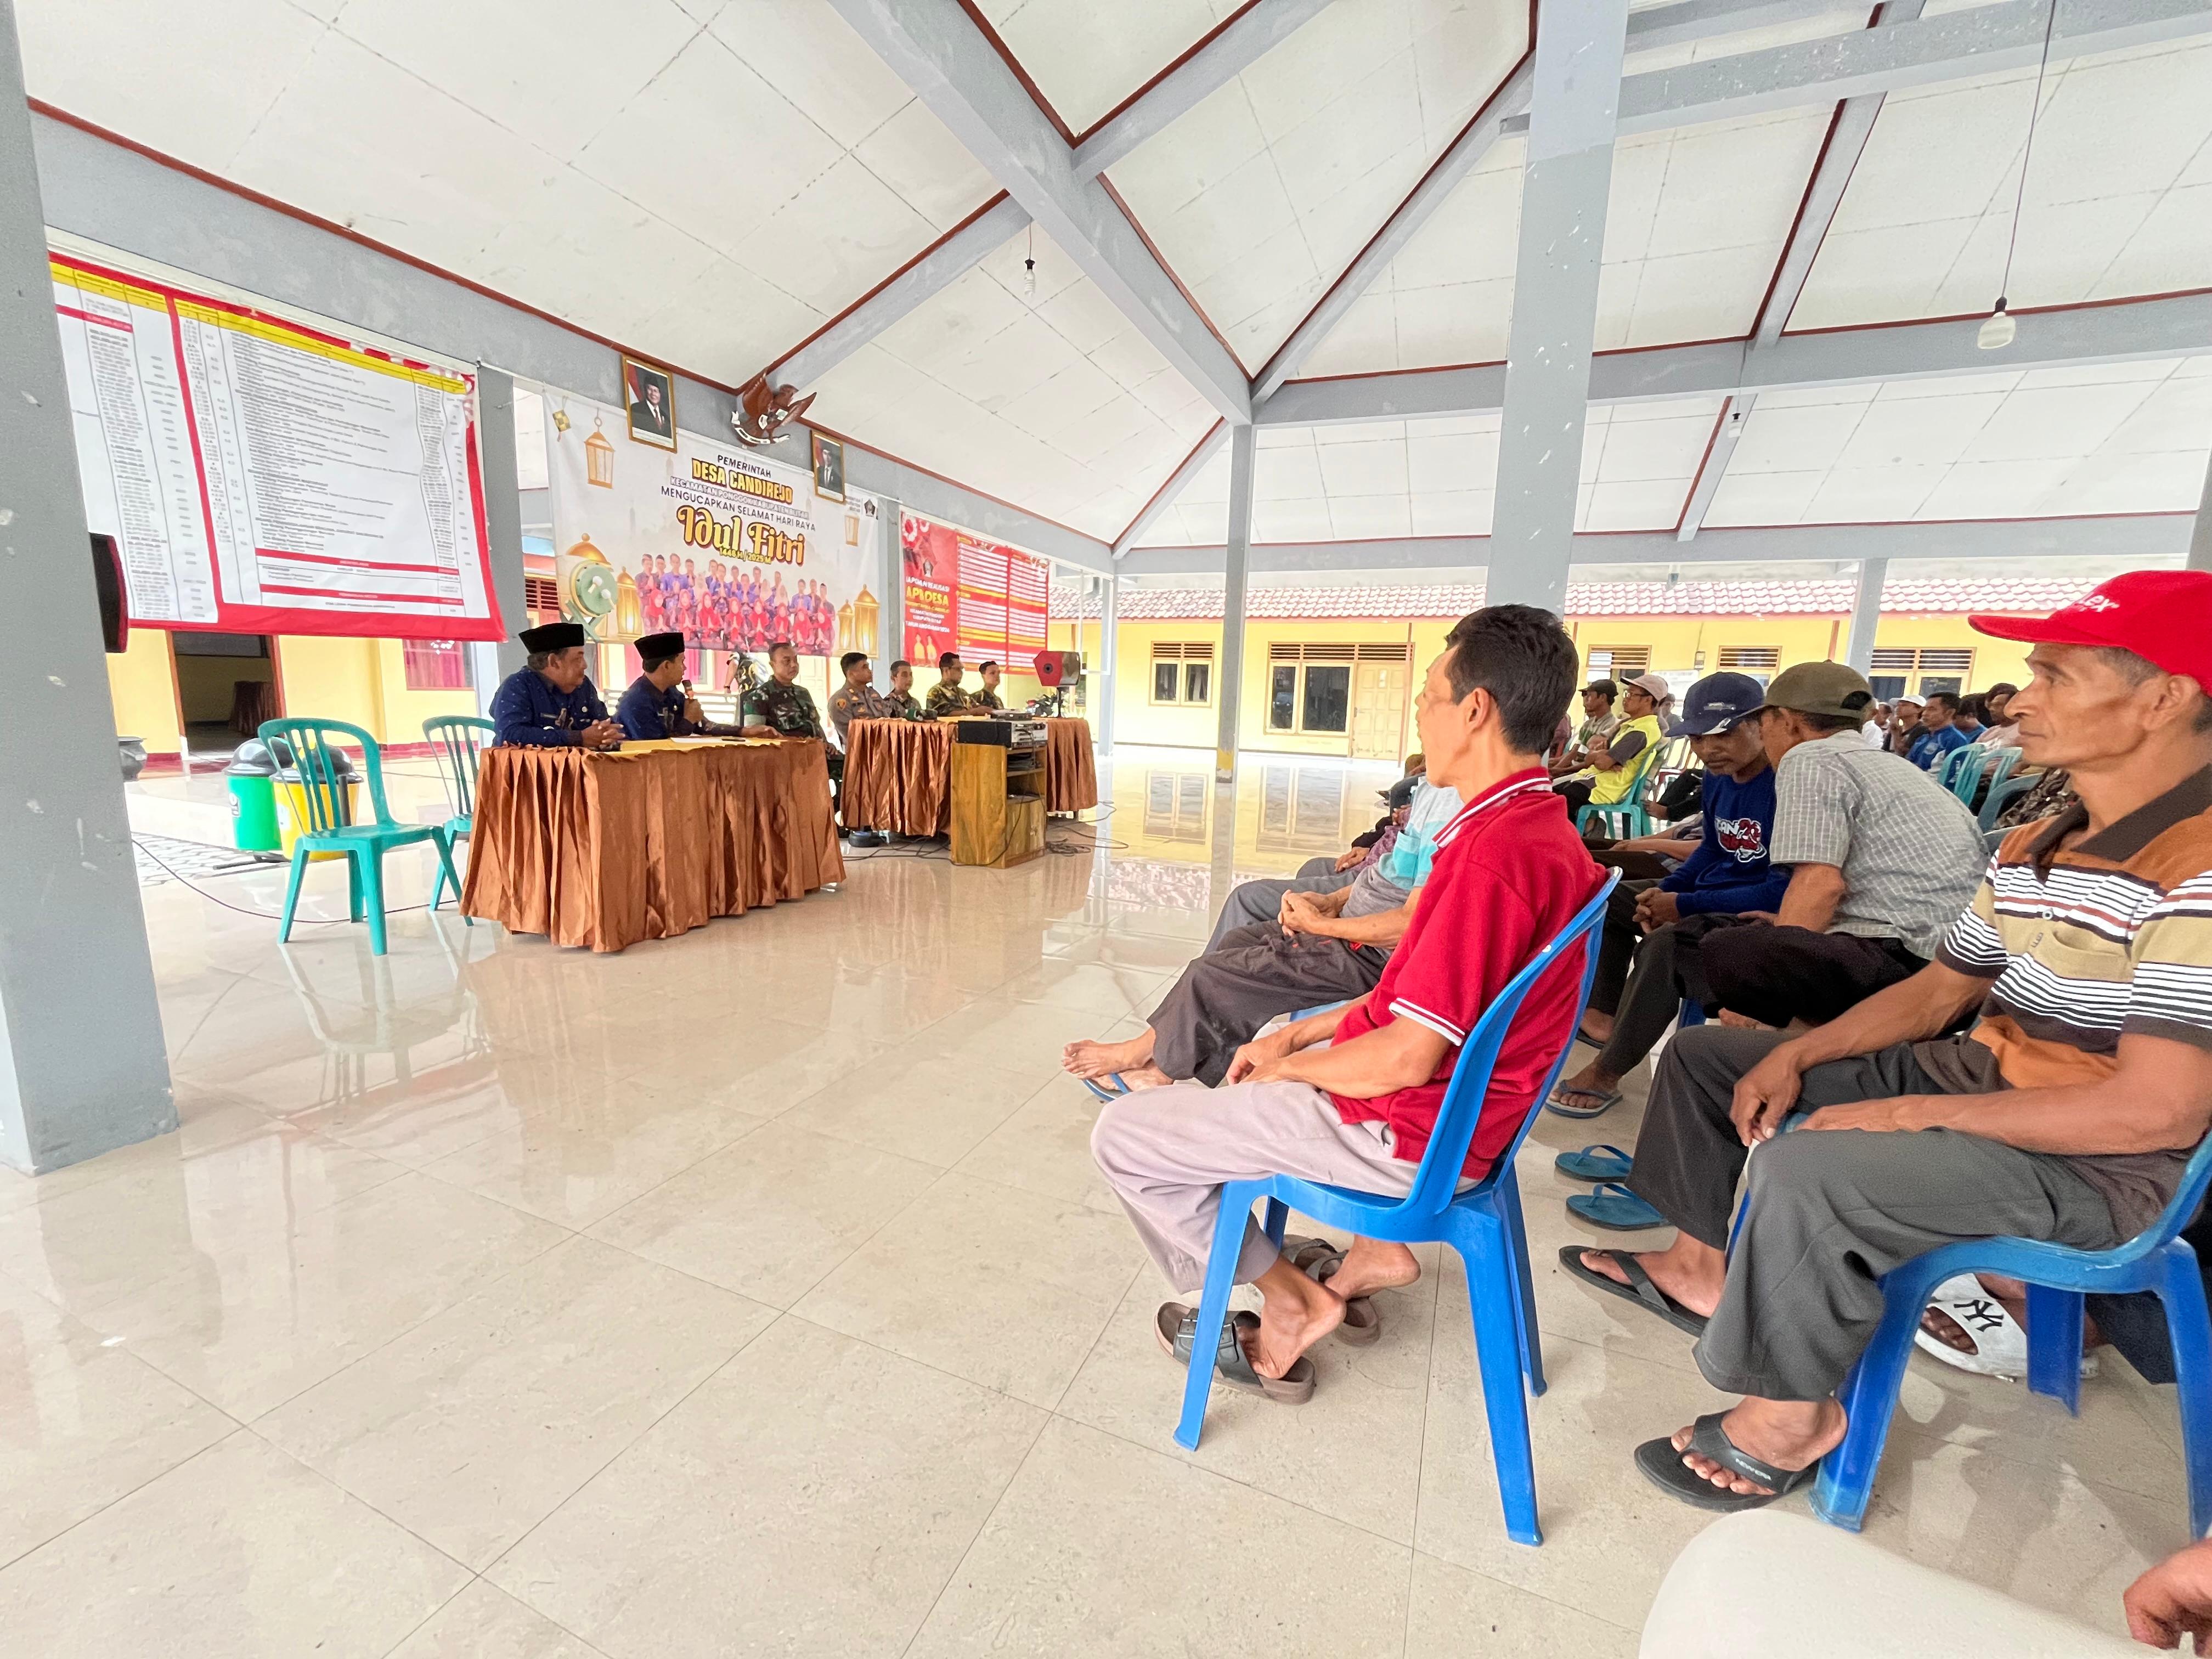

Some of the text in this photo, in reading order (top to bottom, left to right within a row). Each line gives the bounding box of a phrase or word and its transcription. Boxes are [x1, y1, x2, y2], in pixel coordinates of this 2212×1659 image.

[670, 476, 718, 496] KECAMATAN
[692, 458, 793, 504] DESA CANDIREJO
[718, 455, 771, 478] PEMERINTAH
[661, 486, 816, 532] MENGUCAPKAN SELAMAT HARI RAYA
[676, 505, 805, 566] Idul Fitri
